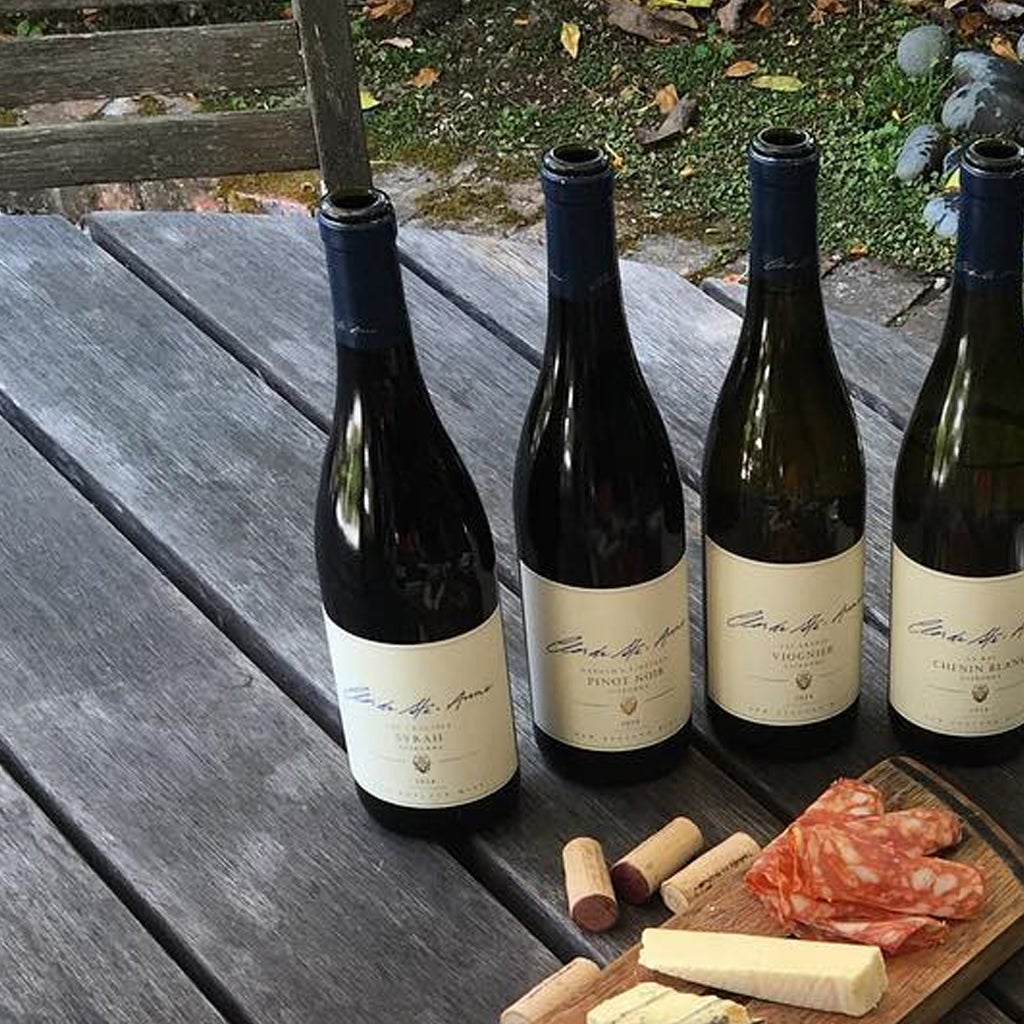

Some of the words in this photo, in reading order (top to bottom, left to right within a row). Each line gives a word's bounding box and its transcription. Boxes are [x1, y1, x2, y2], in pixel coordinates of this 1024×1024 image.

[772, 645, 833, 662] VIOGNIER
[932, 659, 985, 673] CHENIN
[586, 677, 629, 687] PINOT
[634, 667, 664, 683] NOIR
[395, 732, 443, 744] SYRAH
